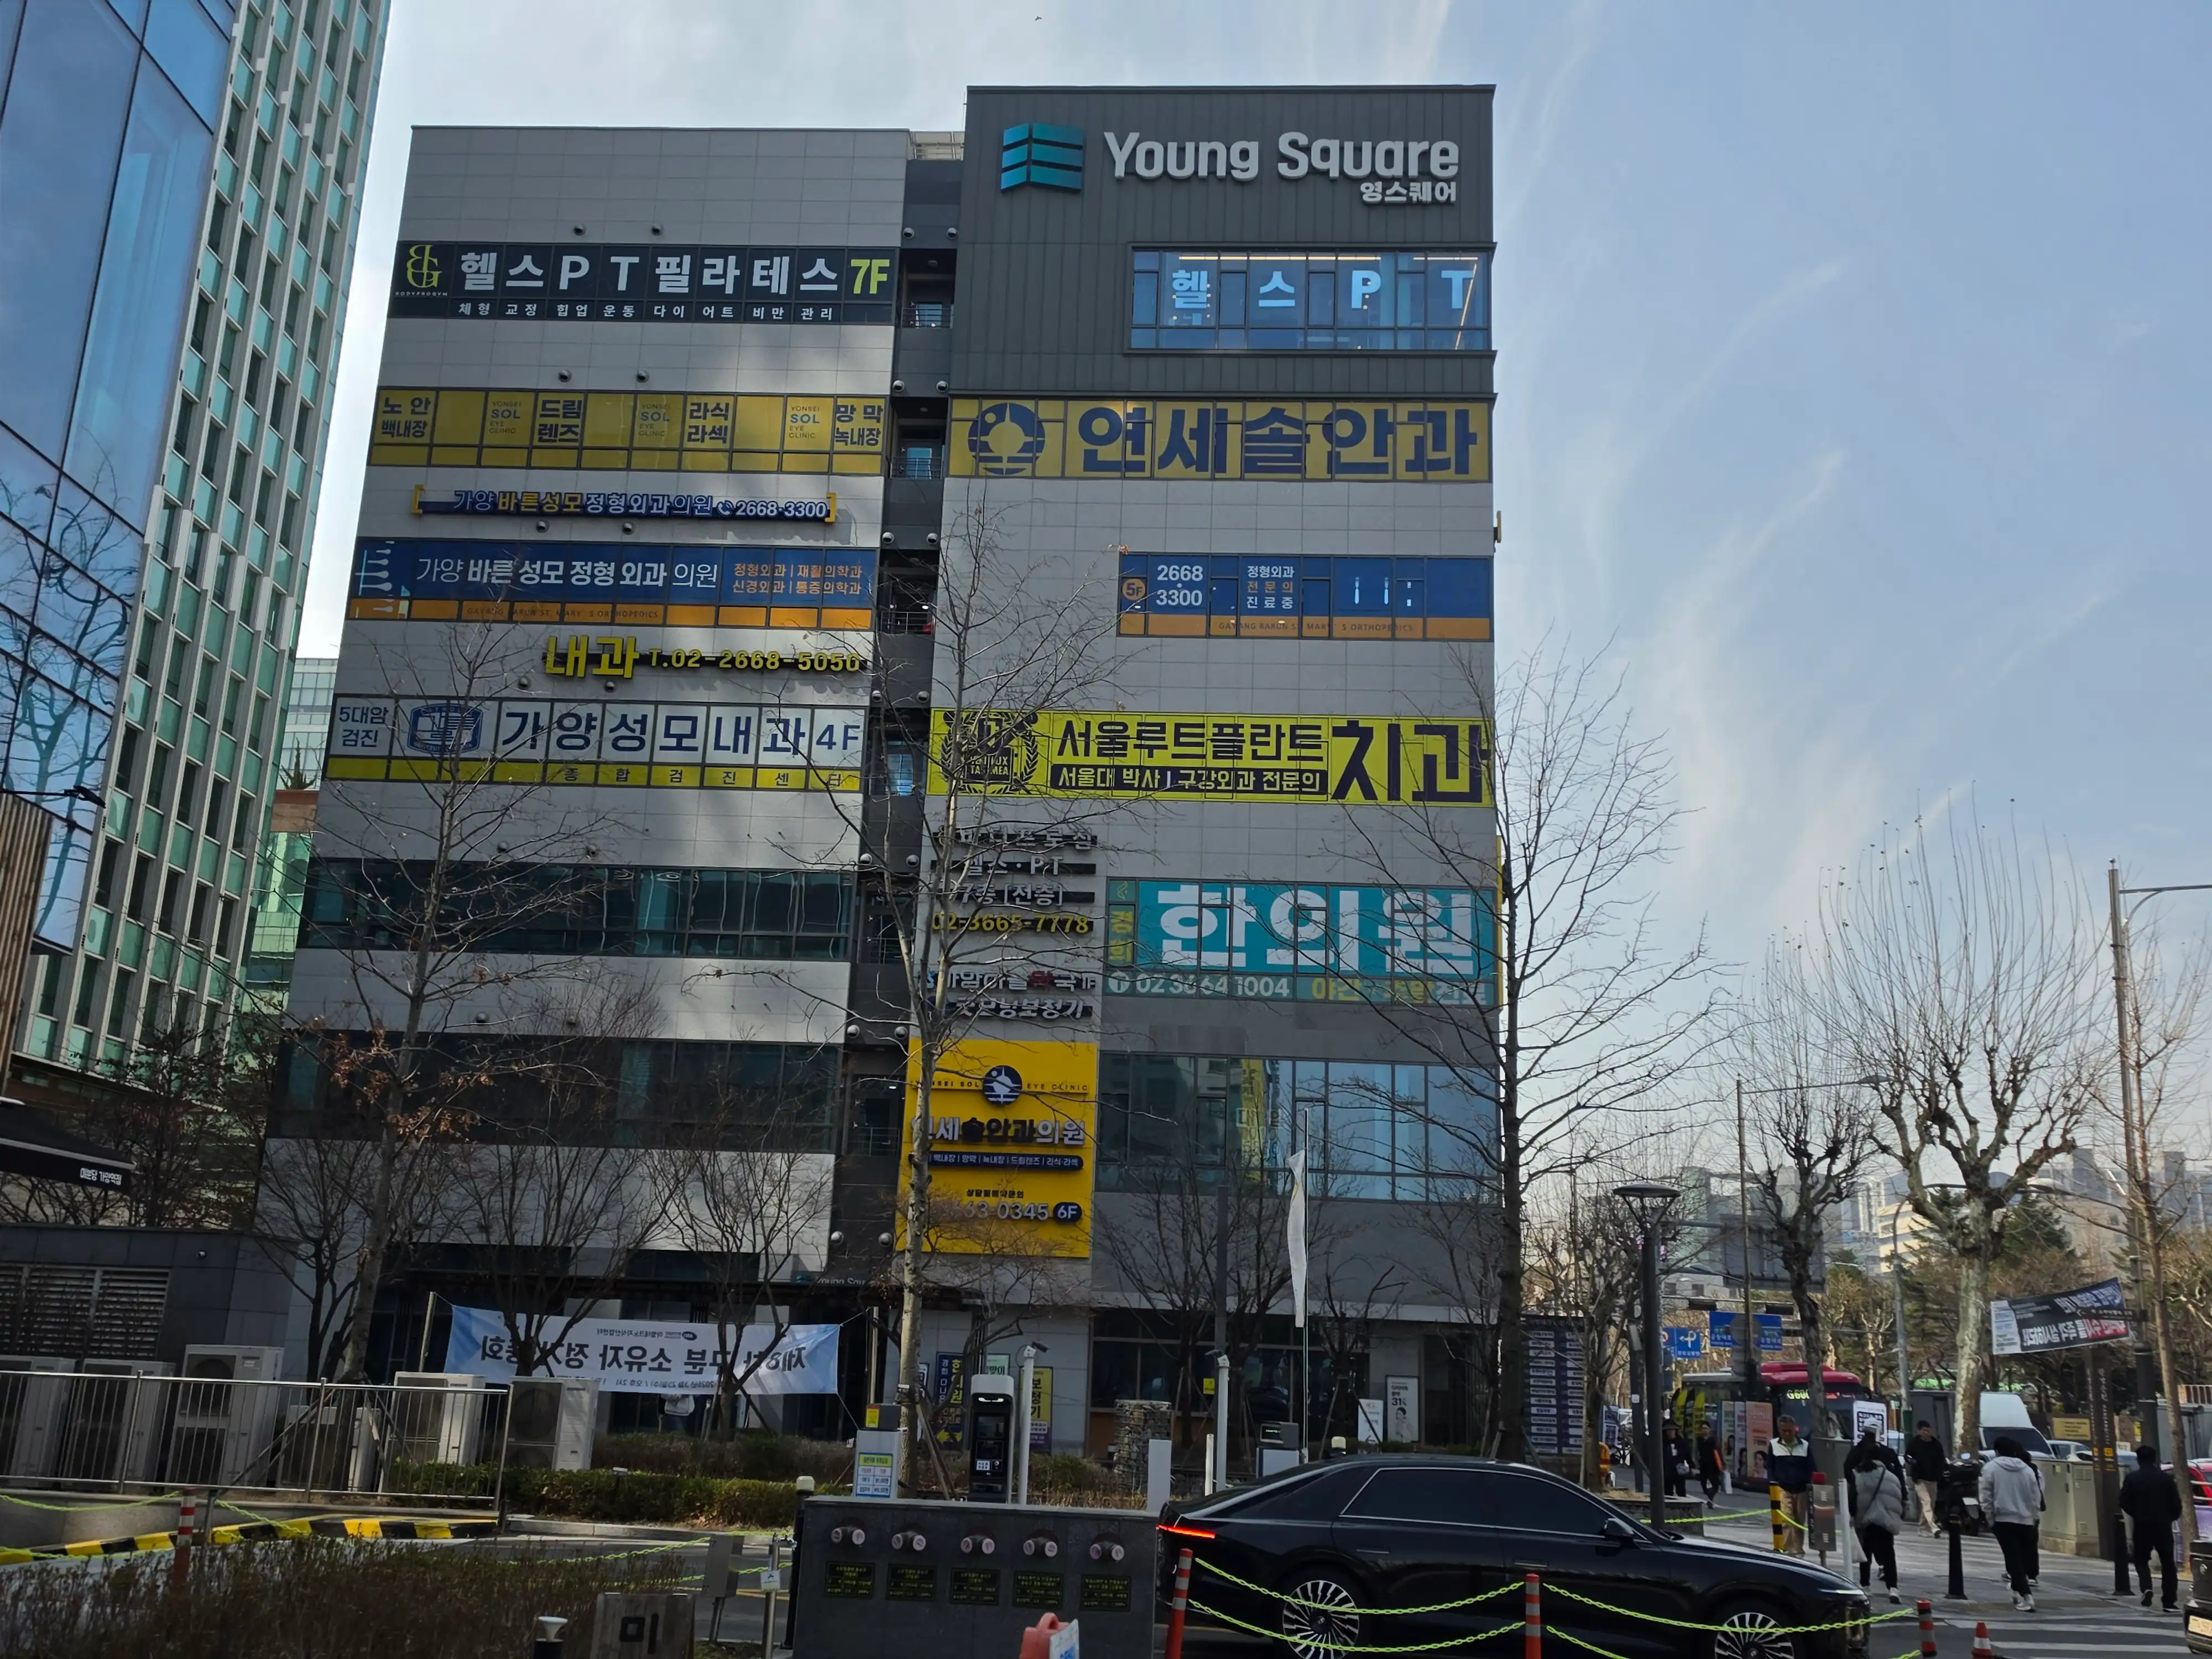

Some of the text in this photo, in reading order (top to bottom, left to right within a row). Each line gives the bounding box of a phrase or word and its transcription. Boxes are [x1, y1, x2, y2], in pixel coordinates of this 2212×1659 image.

[1103, 132, 1459, 181] Young Square
[1360, 181, 1457, 204] 영스퀘어
[461, 252, 544, 291] 헬스
[655, 254, 838, 295] 필라테스
[851, 259, 890, 295] 7F
[1171, 268, 1296, 309] 헬스
[458, 302, 491, 316] 체형
[505, 304, 538, 317] 교정
[556, 304, 588, 317] 힙업
[603, 305, 635, 318] 운동
[752, 306, 785, 320] 비만
[800, 307, 833, 321] 관리
[491, 409, 521, 419] SOL
[539, 399, 583, 419] 드림
[641, 412, 670, 422] SOL
[690, 402, 730, 421] 라식
[790, 414, 820, 424] SOL
[382, 420, 428, 439] 백내장
[537, 423, 581, 443] 렌즈
[687, 425, 728, 444] 라섹
[834, 427, 881, 447] 녹내장
[1078, 406, 1477, 479] 연세솔안과
[672, 563, 718, 589] 의원
[733, 562, 863, 580] 정형외과 재활의학과
[1157, 564, 1203, 582] 2668
[1247, 565, 1295, 578] 정형외과
[732, 579, 862, 596] 신경외과 통증의학과
[1126, 582, 1143, 597] 5F
[1247, 581, 1293, 594] 전문의
[1155, 589, 1203, 607] 3300
[545, 634, 639, 679] 내과
[339, 706, 389, 724] 5대암
[342, 729, 379, 748] 검진
[502, 711, 860, 755] 가양성모내과 4F
[1057, 719, 1491, 803] 서울루트플란트 치과
[564, 767, 842, 787] 종합검진센터
[1058, 766, 1321, 793] 서울대 박사 구강외과 전문의
[1157, 884, 1474, 975] 한의원
[1136, 974, 1165, 993] 02
[1237, 977, 1290, 997] 1004
[1052, 1083, 1088, 1092] CLINIC
[983, 1155, 1005, 1164] 녹내장
[997, 1201, 1049, 1220] 0345
[1057, 1205, 1078, 1219] 6F
